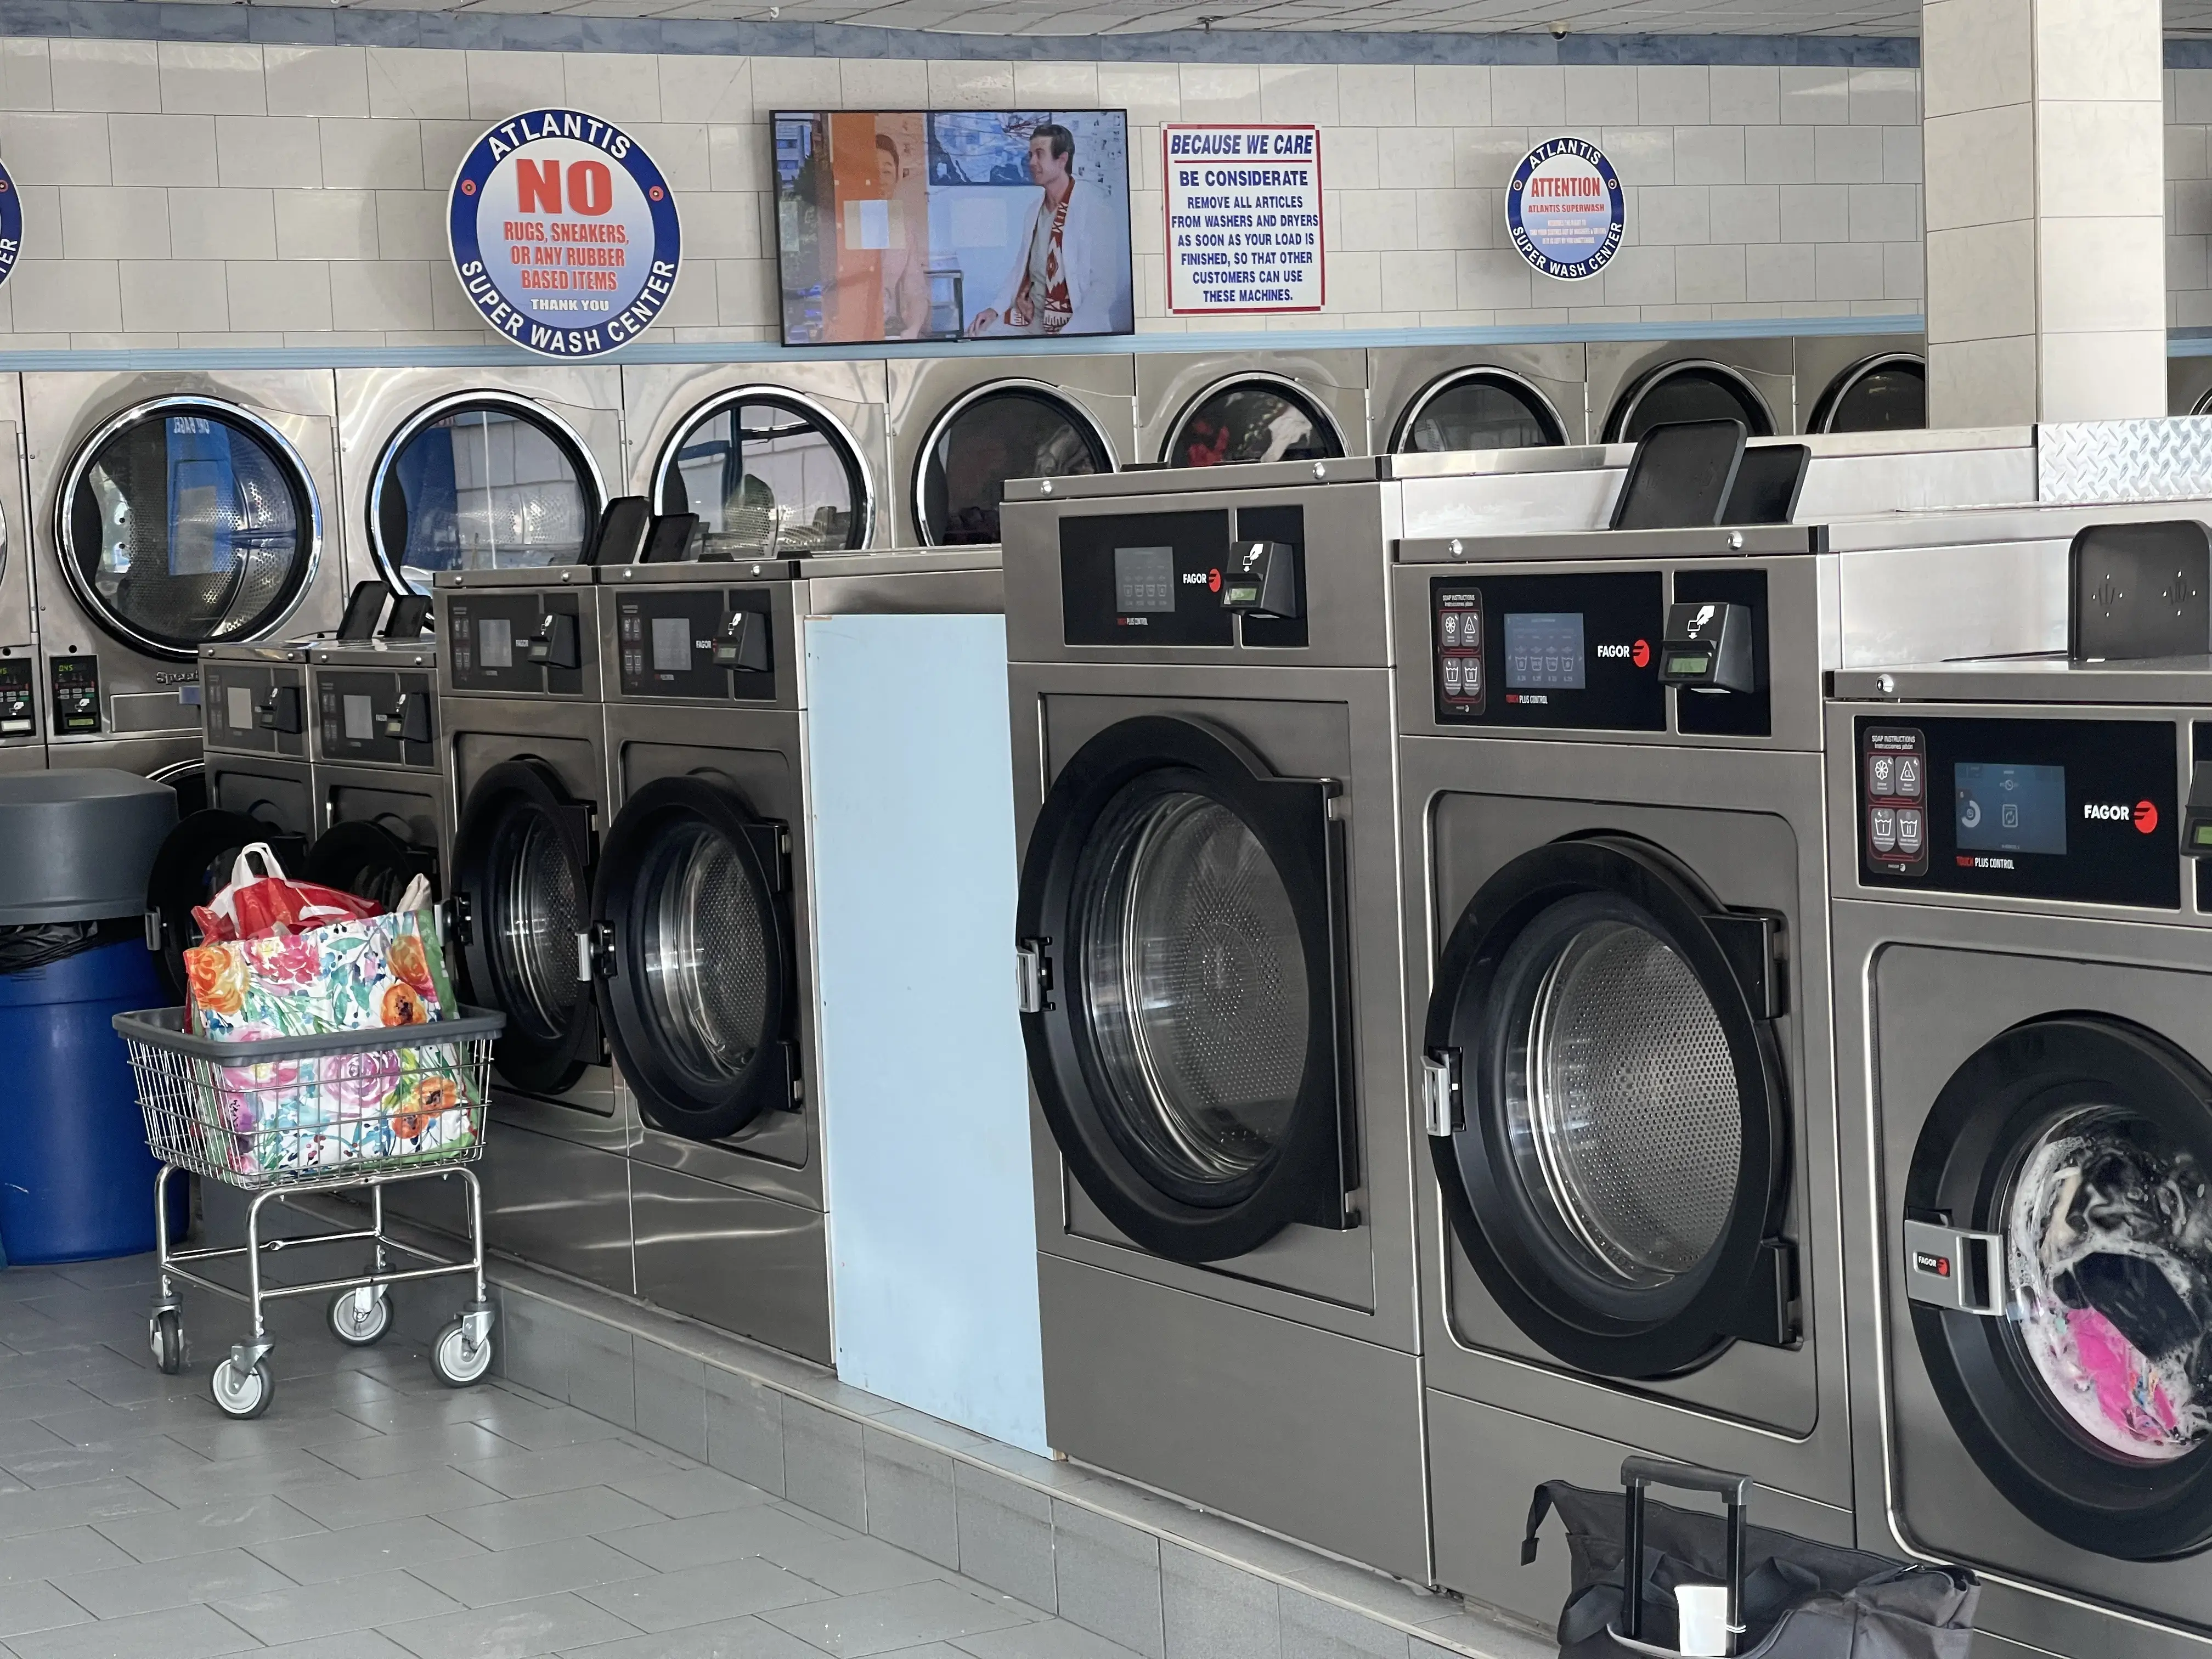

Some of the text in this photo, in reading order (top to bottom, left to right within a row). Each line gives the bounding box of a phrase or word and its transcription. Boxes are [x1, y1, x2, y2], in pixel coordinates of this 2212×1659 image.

[488, 114, 630, 161] ATLANTIS
[1171, 134, 1313, 155] BECAUSE WE CARE
[1529, 139, 1601, 170] ATLANTIS
[1180, 171, 1308, 187] BE CONSIDERATE
[516, 159, 612, 216] NO
[1531, 177, 1600, 197] ATTENTION
[1188, 196, 1303, 209] REMOVE ALL ARTICLES
[1528, 204, 1605, 213] ATLANTIS SUPERWASH
[1172, 215, 1318, 228] FROM WASHERS AND DRYERS
[504, 221, 629, 245] RUGS, SNEAKERS,
[1178, 233, 1314, 247] AS SOON AS YOUR LOAD IS
[511, 245, 625, 267] OR ANY RUBBER
[1513, 222, 1622, 277] SUPER WASH CENTER
[1181, 251, 1313, 267] FINISHED, SO THAT OTHER
[521, 270, 617, 291] BASED ITEMS
[1193, 270, 1303, 284] CUSTOMERS CAN USE
[1203, 289, 1293, 302] THESE MACHINES.
[462, 261, 675, 353] SUPER WASH CENTER
[531, 298, 609, 311] THANK YOU
[1183, 573, 1207, 584] FAGOR
[696, 640, 712, 648] FAGOR
[1597, 645, 1630, 657] FAGOR
[1519, 695, 1530, 703] PLUS
[2084, 804, 2129, 820] FAGOR
[1975, 857, 1989, 868] PLUS
[1989, 858, 2015, 870] CONTROL
[1918, 1256, 1937, 1267] FAGOR
